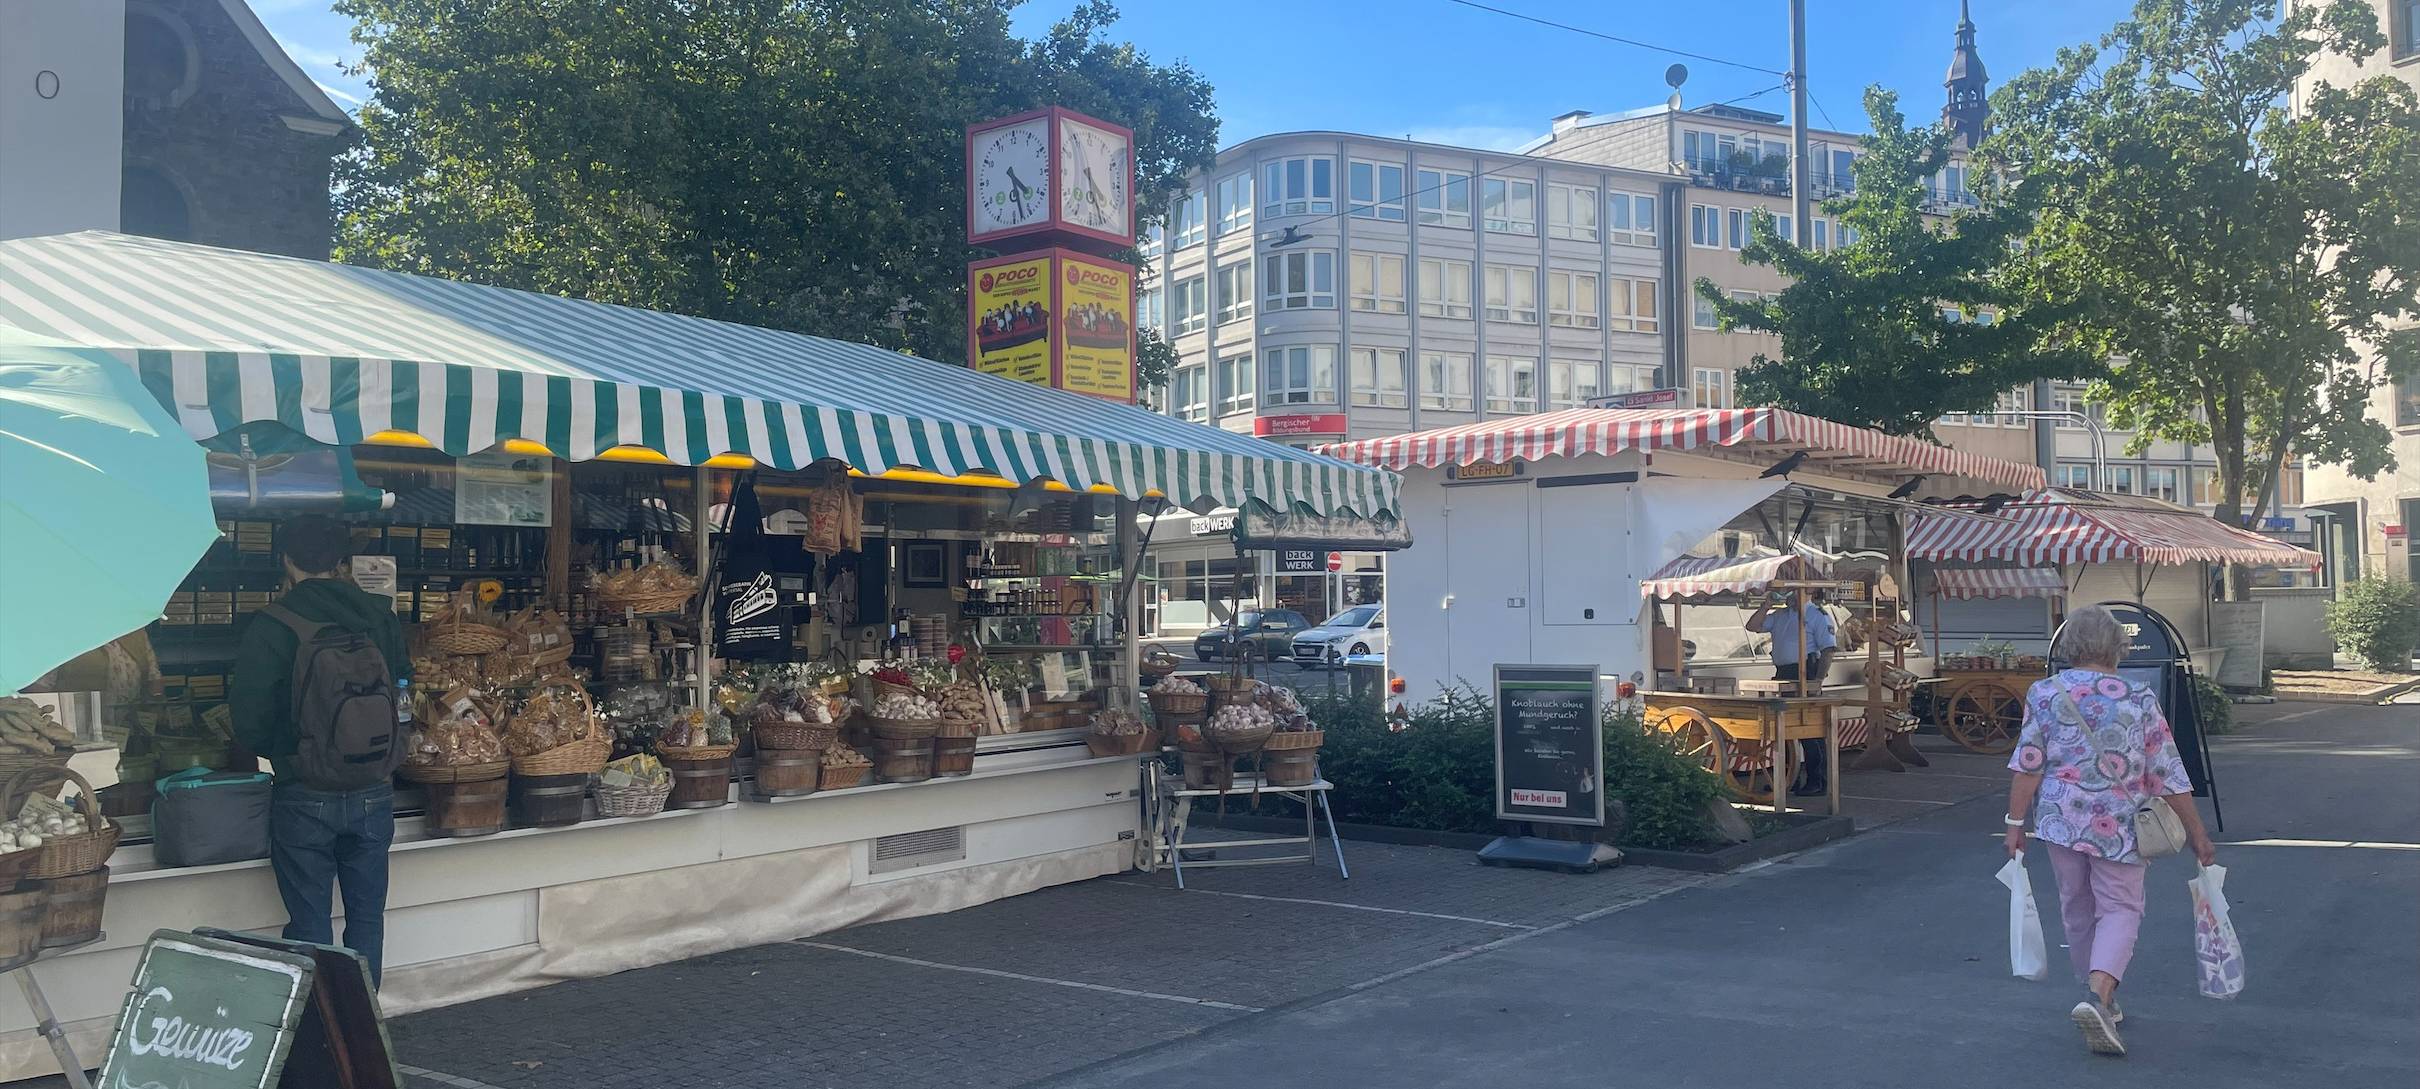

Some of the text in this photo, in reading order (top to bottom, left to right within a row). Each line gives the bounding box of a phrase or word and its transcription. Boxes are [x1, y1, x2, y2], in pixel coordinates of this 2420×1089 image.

[995, 267, 1038, 286] POCO
[1081, 270, 1119, 286] POCO
[1272, 419, 1310, 428] Bergischer
[1286, 551, 1313, 559] back
[1286, 561, 1314, 570] WERK
[1511, 699, 1585, 709] Knoblauch ohne
[1518, 710, 1578, 721] Mundgeruch?
[1513, 792, 1562, 804] Nur bei uns
